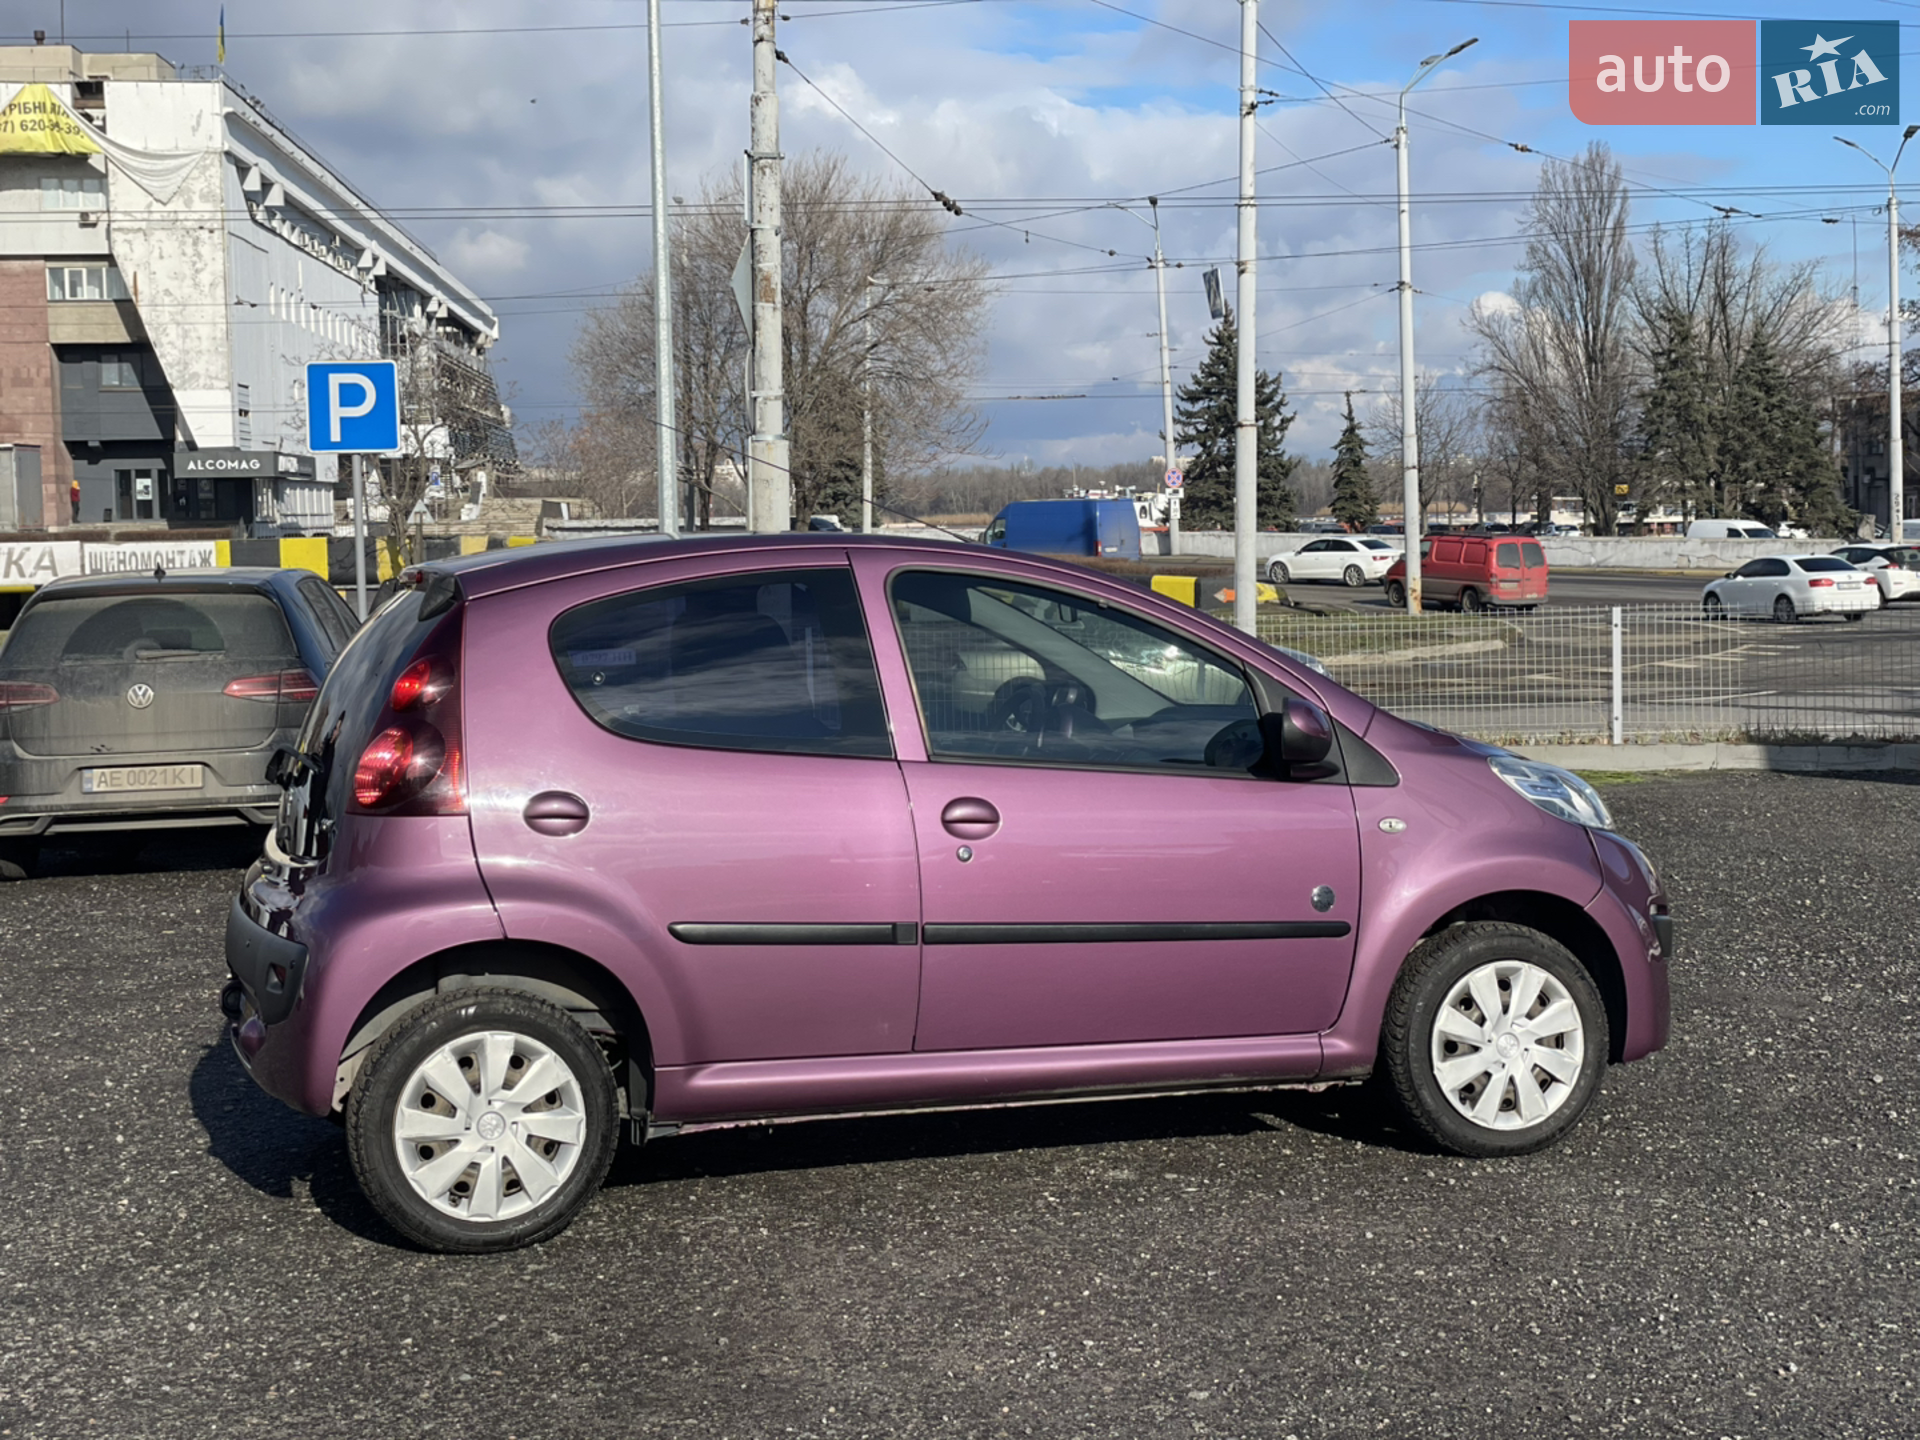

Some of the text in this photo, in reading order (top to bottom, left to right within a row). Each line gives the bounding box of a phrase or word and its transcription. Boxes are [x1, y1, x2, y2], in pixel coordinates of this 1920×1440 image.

[328, 372, 376, 443] P
[187, 459, 261, 471] ALCOMAG
[88, 549, 214, 573] ШИНОМОНТАЖ
[97, 771, 122, 788] AE
[127, 769, 168, 786] 0021
